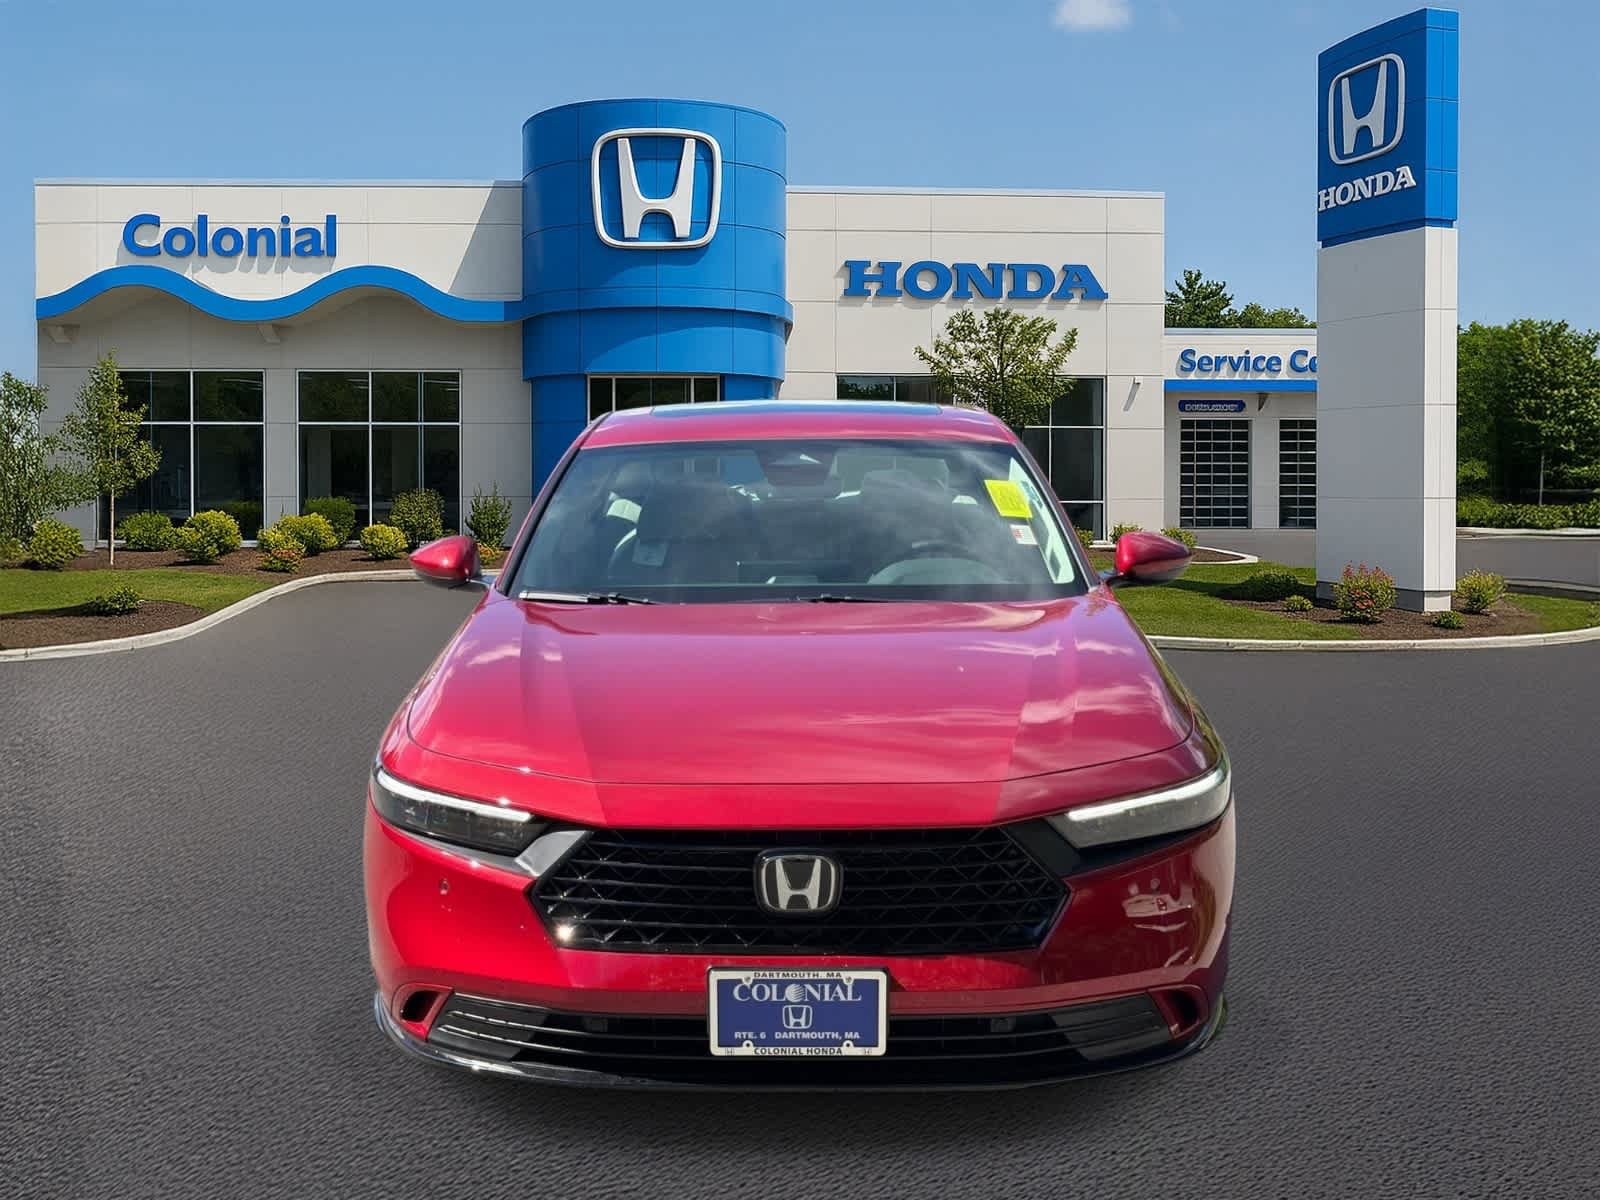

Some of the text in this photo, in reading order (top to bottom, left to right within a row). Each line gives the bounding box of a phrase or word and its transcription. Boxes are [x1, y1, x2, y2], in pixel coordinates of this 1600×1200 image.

[1318, 165, 1417, 212] HONDA
[122, 213, 337, 257] Colonial
[843, 260, 1109, 300] HONDA
[1180, 348, 1282, 373] Service
[733, 983, 862, 1003] COLONIAL
[774, 1031, 842, 1040] DARTMOUTH,
